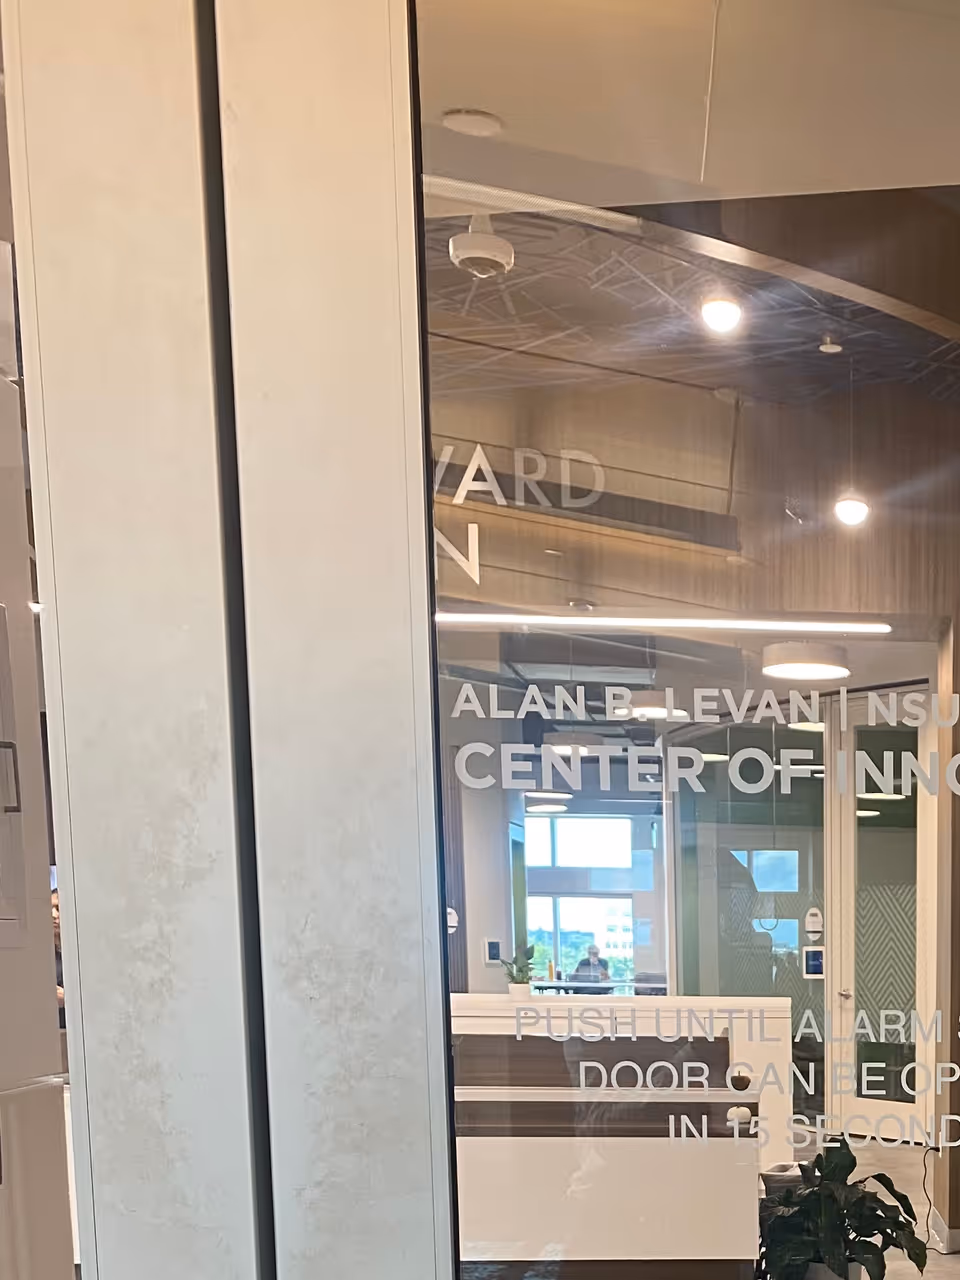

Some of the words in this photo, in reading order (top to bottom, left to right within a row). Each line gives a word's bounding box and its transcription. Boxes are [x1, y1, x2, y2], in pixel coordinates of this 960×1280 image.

[450, 683, 586, 721] ALAN
[604, 685, 648, 722] B.
[664, 686, 820, 725] LEVAN
[867, 691, 960, 728] NSU
[454, 742, 707, 793] CENTER
[727, 747, 815, 795] OF
[515, 1006, 637, 1042] PUSH
[655, 1008, 782, 1043] UNTIL
[793, 1009, 943, 1044] ALARM
[579, 1060, 710, 1096] DOOR
[725, 1061, 815, 1096] CAN
[832, 1062, 887, 1096] BE
[668, 1114, 708, 1146] IN
[727, 1115, 770, 1148] 15
